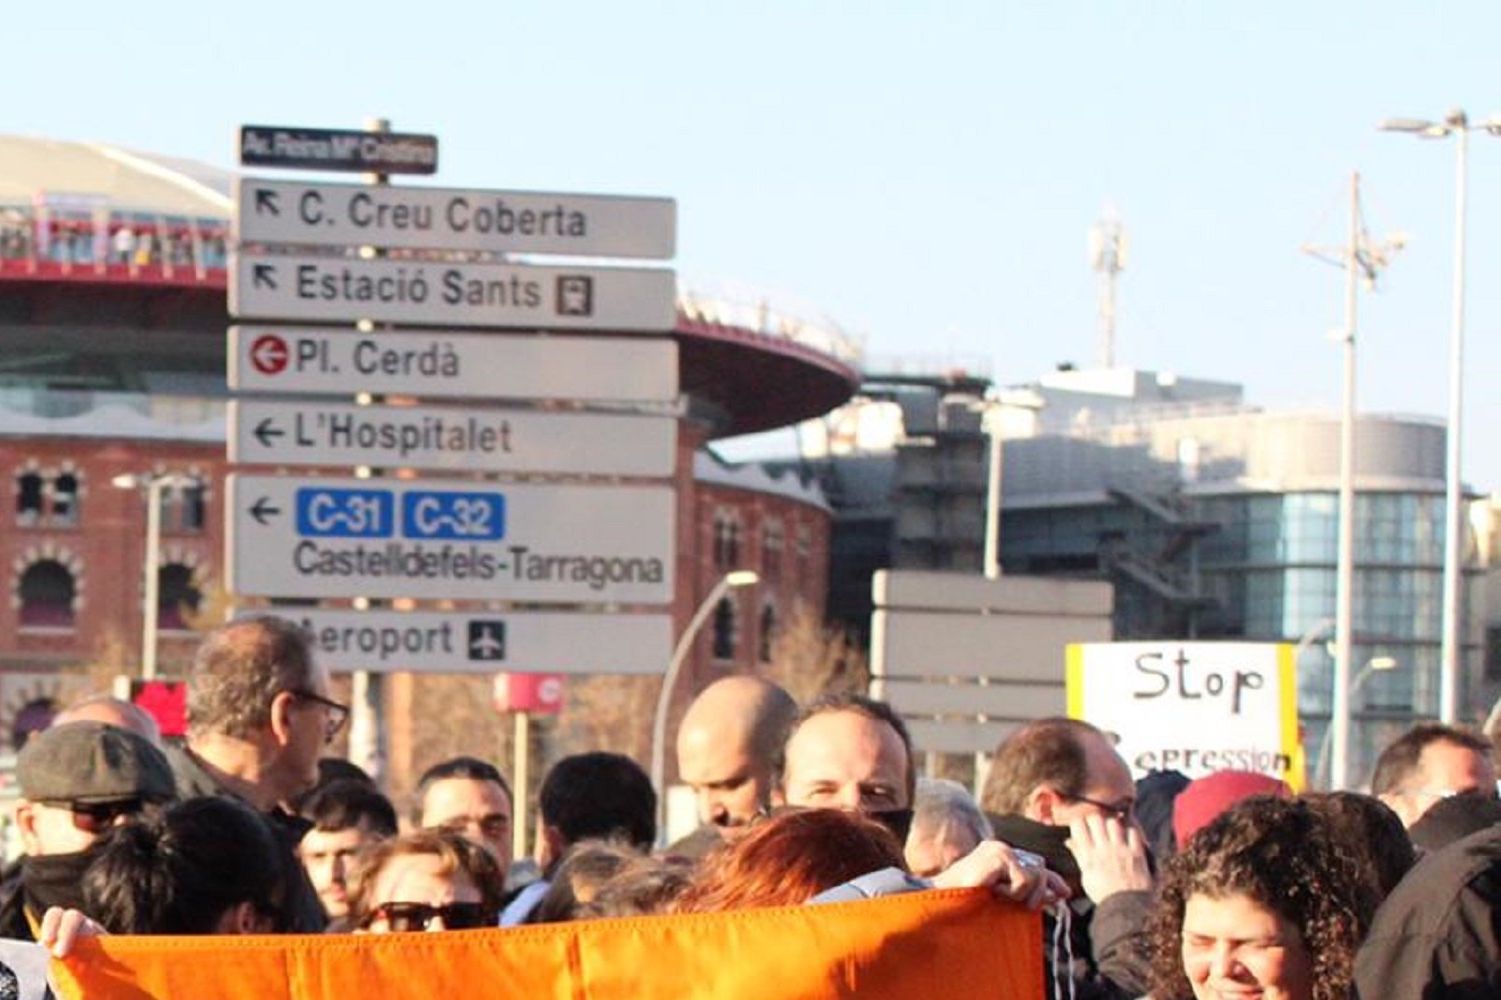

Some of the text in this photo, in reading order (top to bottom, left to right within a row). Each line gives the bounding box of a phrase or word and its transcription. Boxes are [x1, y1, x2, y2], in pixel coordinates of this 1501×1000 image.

[299, 189, 586, 238] C. Creu Coberta
[296, 264, 542, 309] Estació Sants
[296, 339, 460, 378] Pl. Cerdà
[294, 412, 513, 457] L'Hospitalet
[308, 493, 492, 536] C-31 C-32
[294, 541, 663, 590] Castelldefels-Tarragona
[1133, 648, 1264, 714] Stop
[1108, 736, 1293, 776] epression
